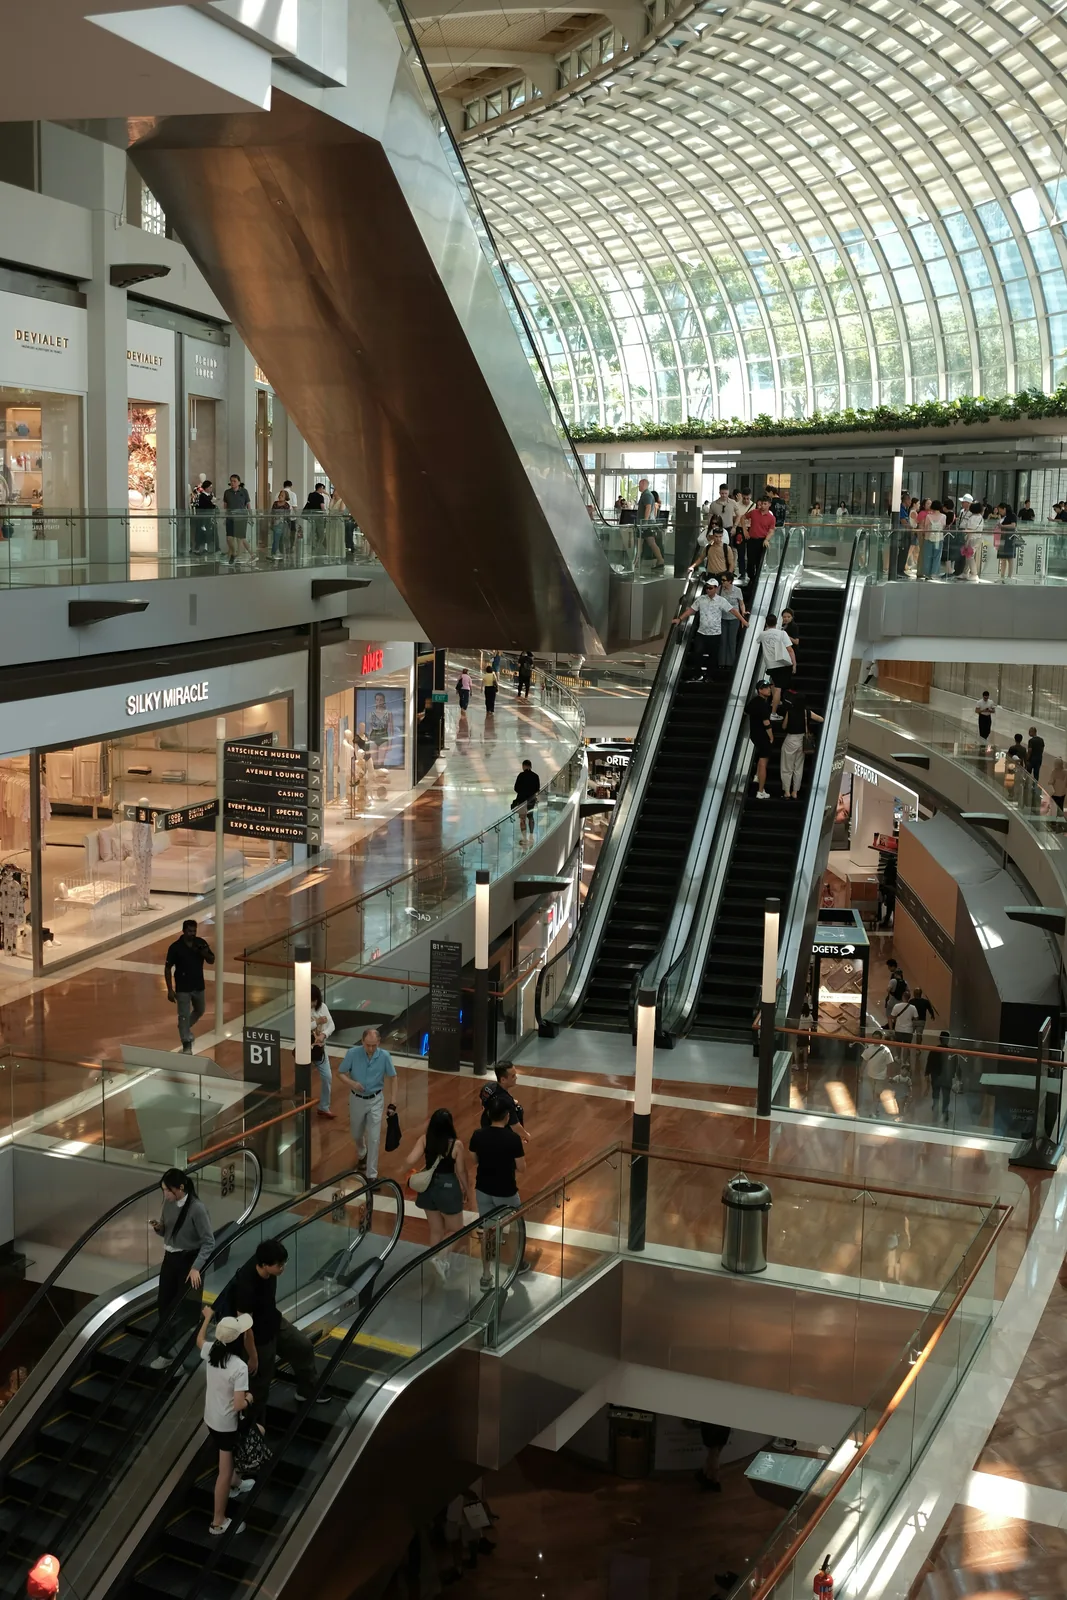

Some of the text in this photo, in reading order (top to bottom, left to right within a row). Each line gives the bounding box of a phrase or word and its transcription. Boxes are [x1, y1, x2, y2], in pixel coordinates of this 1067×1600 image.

[15, 329, 69, 348] DEVIALET
[127, 350, 163, 366] DEVIALET
[683, 501, 689, 513] 1
[127, 681, 209, 715] SILKY MIRACLE
[227, 747, 268, 757] ARTSCIENCE
[270, 751, 301, 760] MUSEUM
[245, 768, 305, 780] AVENUE LOUNGE
[854, 763, 878, 786] SEPHORA
[277, 790, 305, 799] CASINO
[228, 802, 246, 811] EVENT
[247, 805, 266, 814] PLAZA
[276, 808, 304, 817] SPECTRA
[230, 821, 248, 830] EXPO
[249, 823, 254, 831] &
[255, 824, 304, 836] CONVENTION
[812, 945, 839, 954] DGETS
[246, 1031, 276, 1042] LEVEL
[250, 1044, 272, 1066] B1
